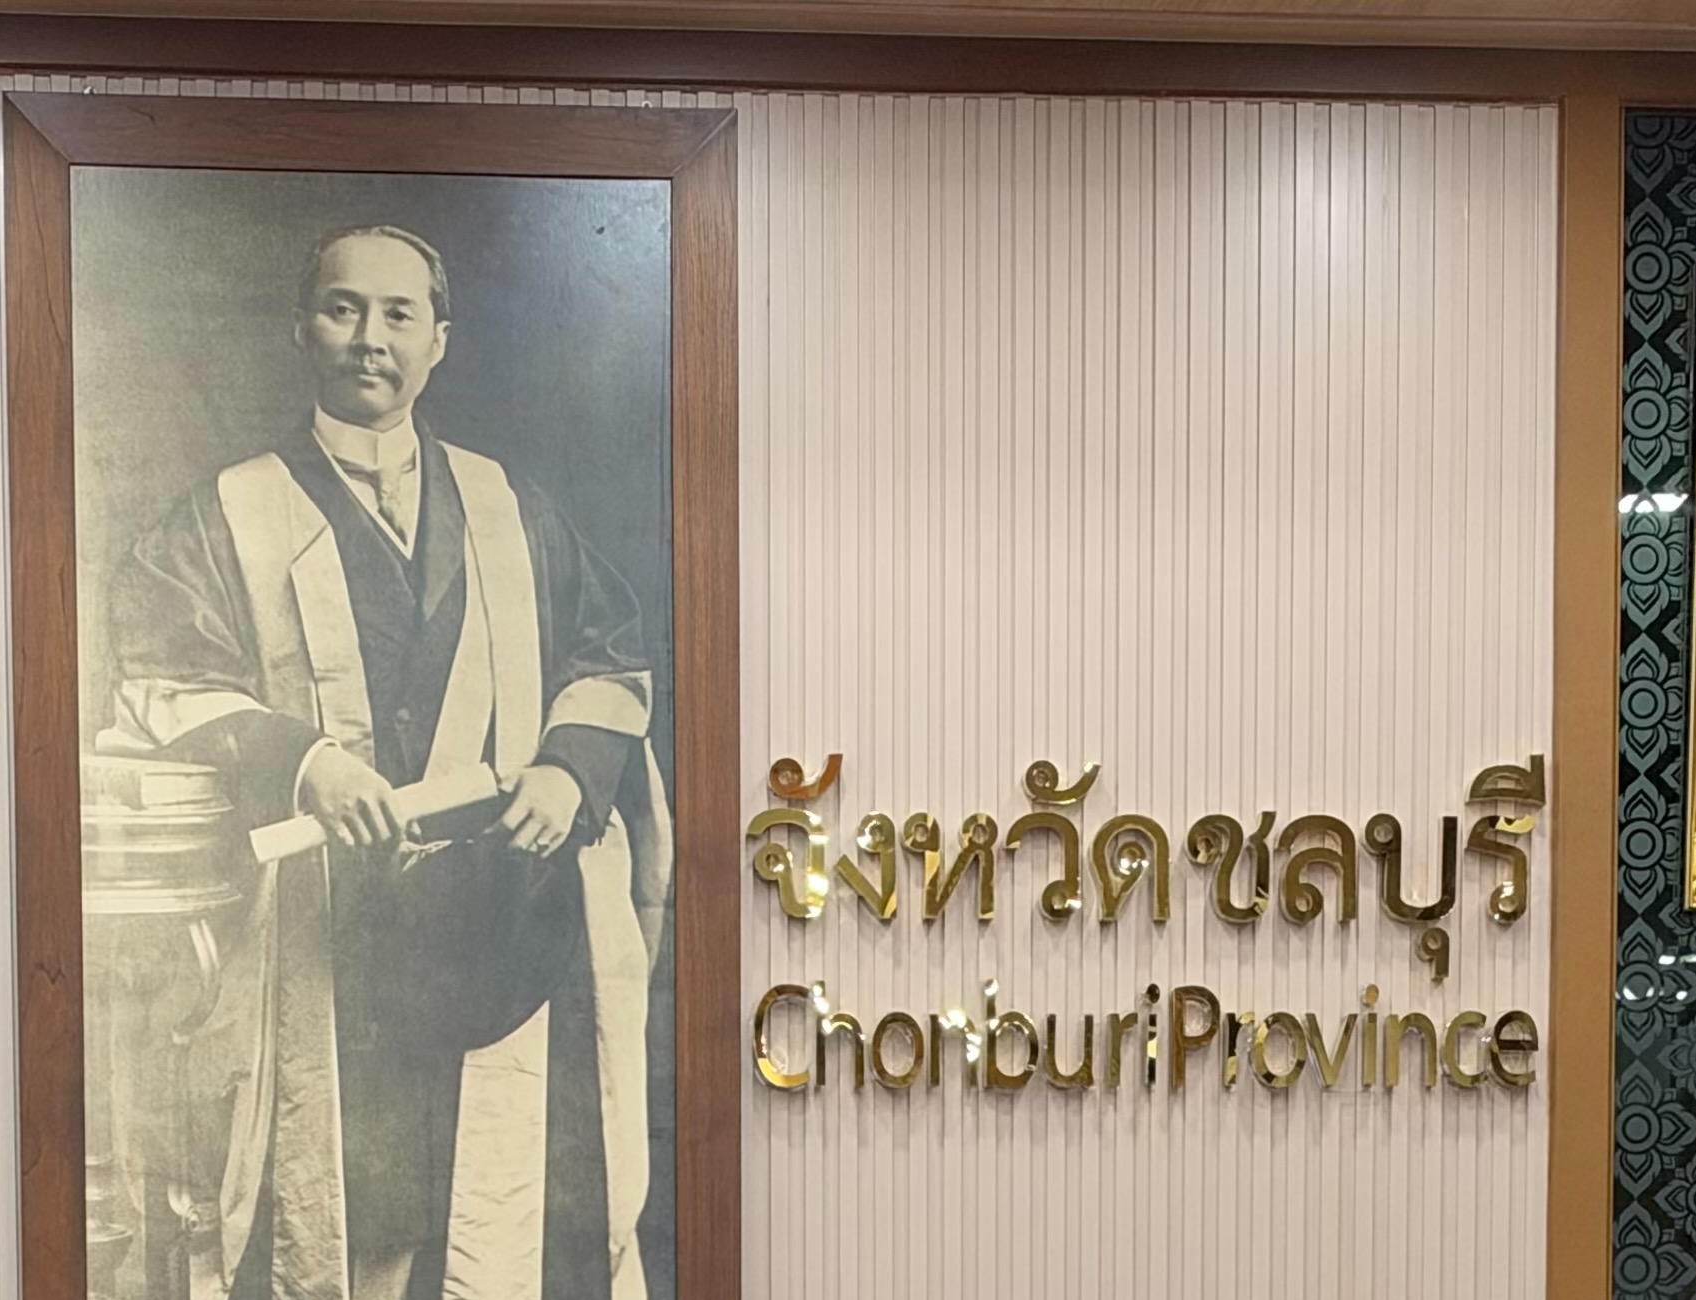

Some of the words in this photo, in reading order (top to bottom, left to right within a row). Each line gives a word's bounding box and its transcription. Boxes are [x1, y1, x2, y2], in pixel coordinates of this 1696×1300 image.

[746, 752, 1546, 983] จังหวัดชลบุรี
